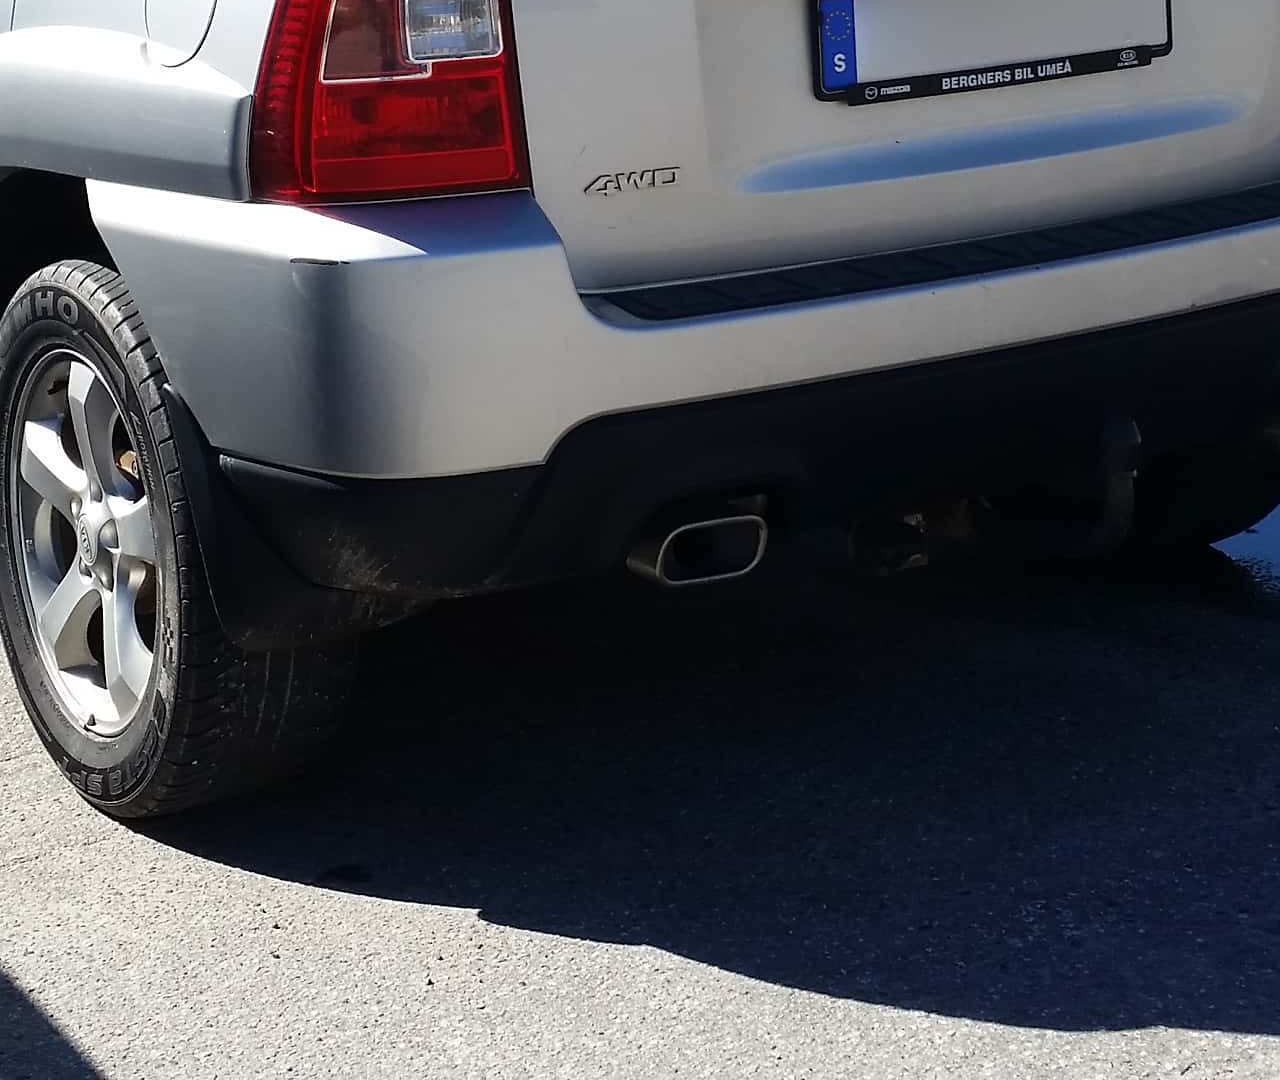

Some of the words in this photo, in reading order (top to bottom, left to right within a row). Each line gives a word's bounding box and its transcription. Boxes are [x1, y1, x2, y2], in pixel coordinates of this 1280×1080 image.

[833, 52, 847, 73] S
[941, 69, 1011, 90] BERGNERS
[1014, 66, 1035, 81] BIL
[1038, 59, 1073, 78] UMEÅ
[584, 166, 680, 197] 4WD
